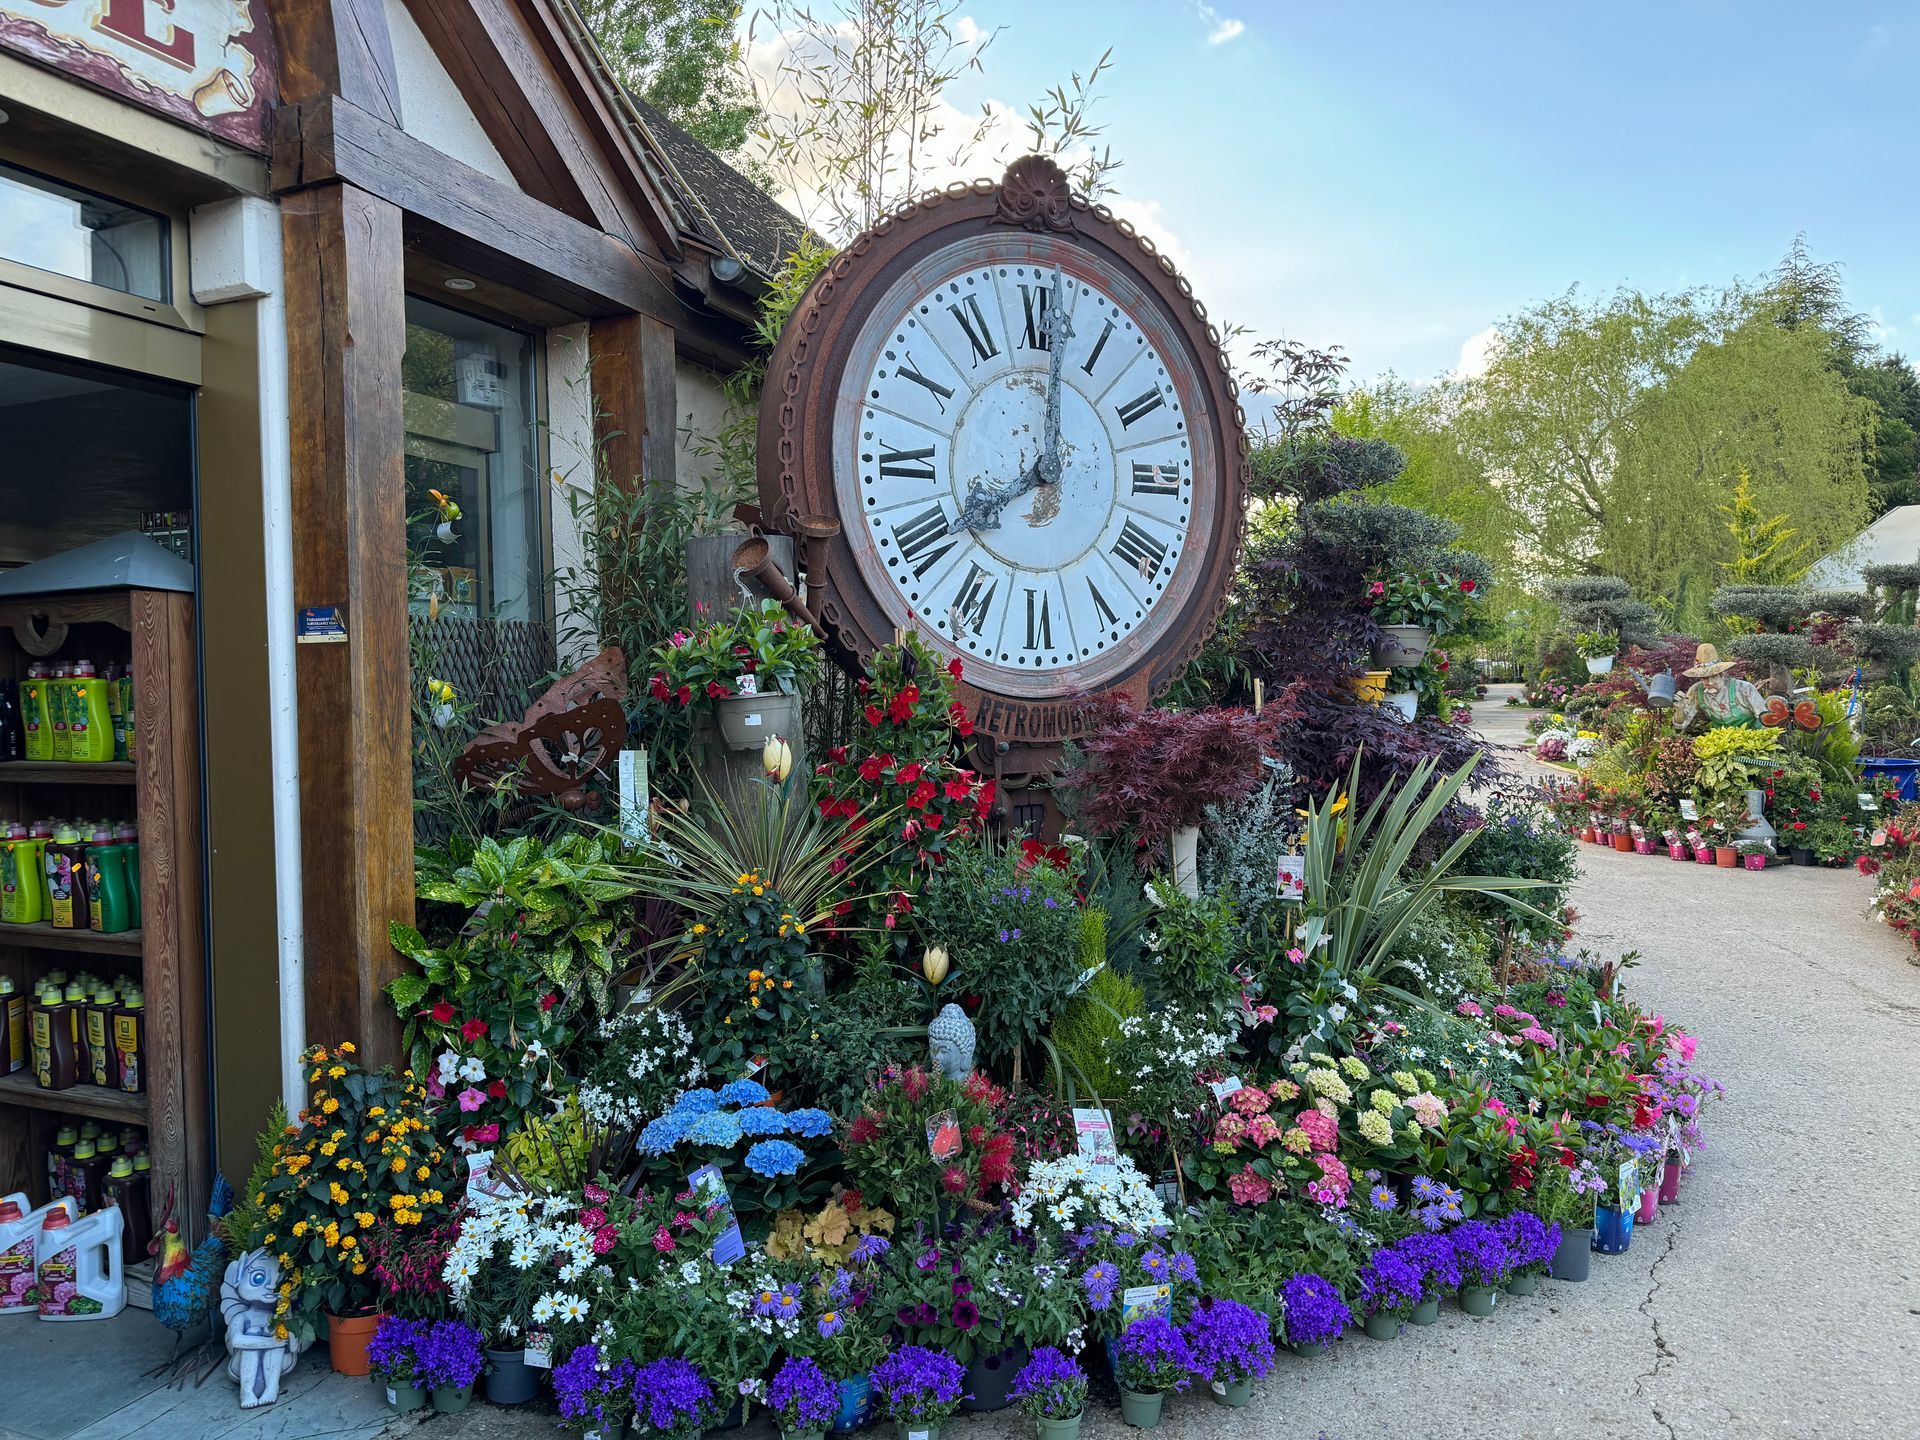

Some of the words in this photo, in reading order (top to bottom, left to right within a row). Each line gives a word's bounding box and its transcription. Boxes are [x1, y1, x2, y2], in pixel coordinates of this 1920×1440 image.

[946, 293, 1001, 369] XI
[895, 351, 955, 415] X
[1115, 381, 1166, 431] II
